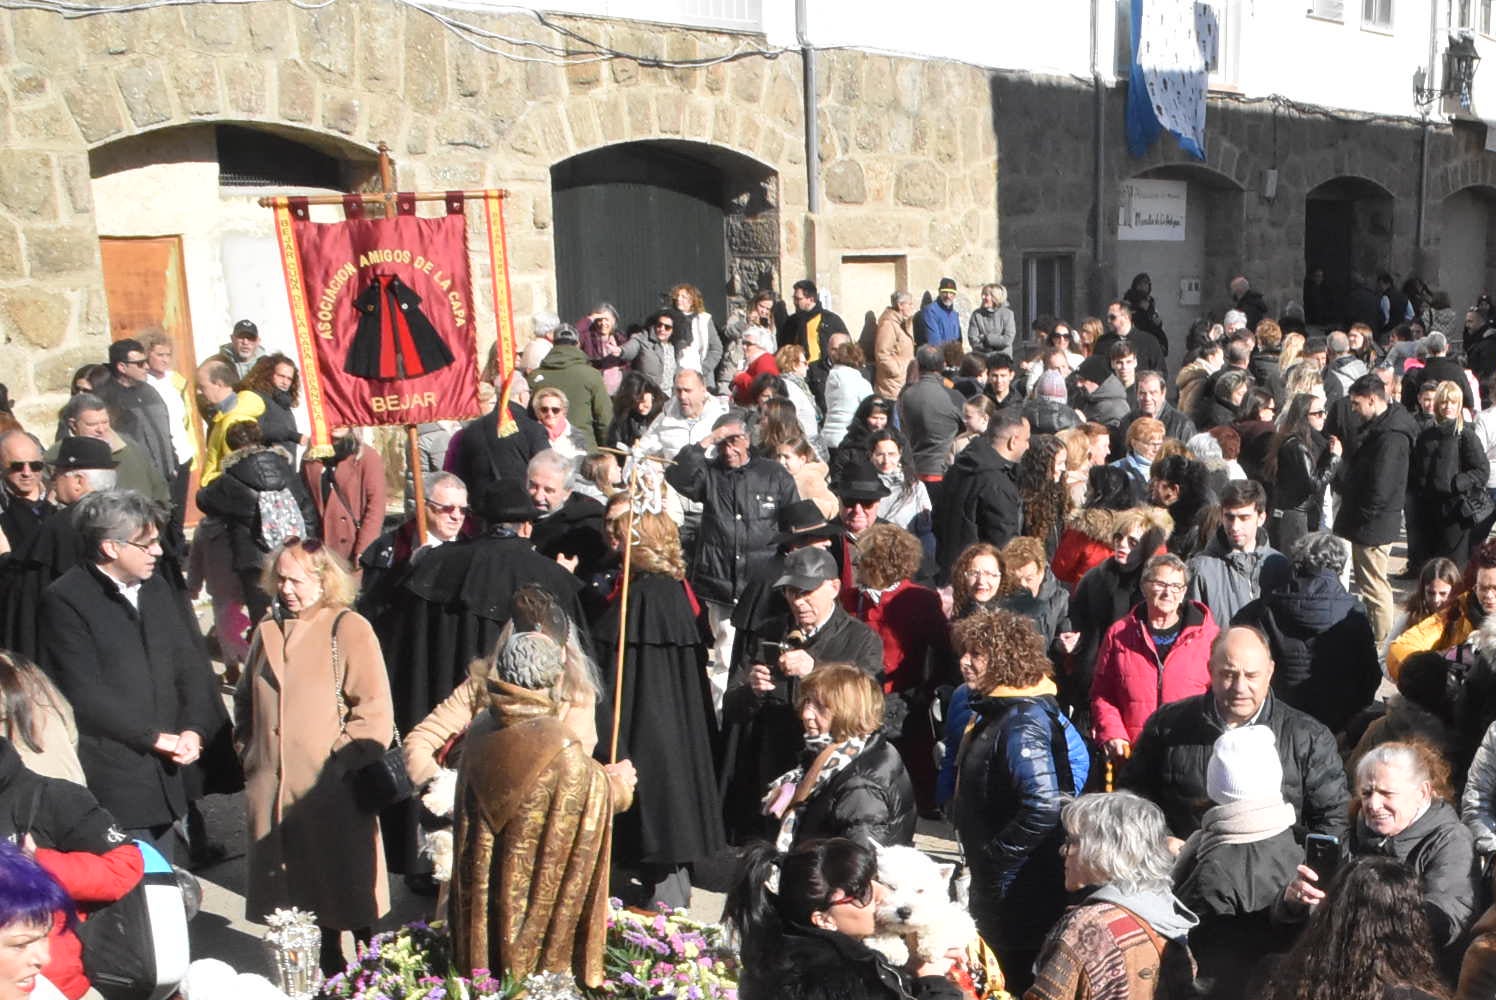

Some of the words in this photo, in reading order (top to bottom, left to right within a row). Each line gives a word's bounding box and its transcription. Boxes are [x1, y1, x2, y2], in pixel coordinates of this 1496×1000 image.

[318, 261, 357, 340] ASOCIACION
[359, 249, 412, 268] AMIGOS
[413, 256, 434, 274] DE
[433, 271, 451, 291] LA
[448, 291, 466, 328] CAPA
[371, 391, 438, 413] BEJAR
